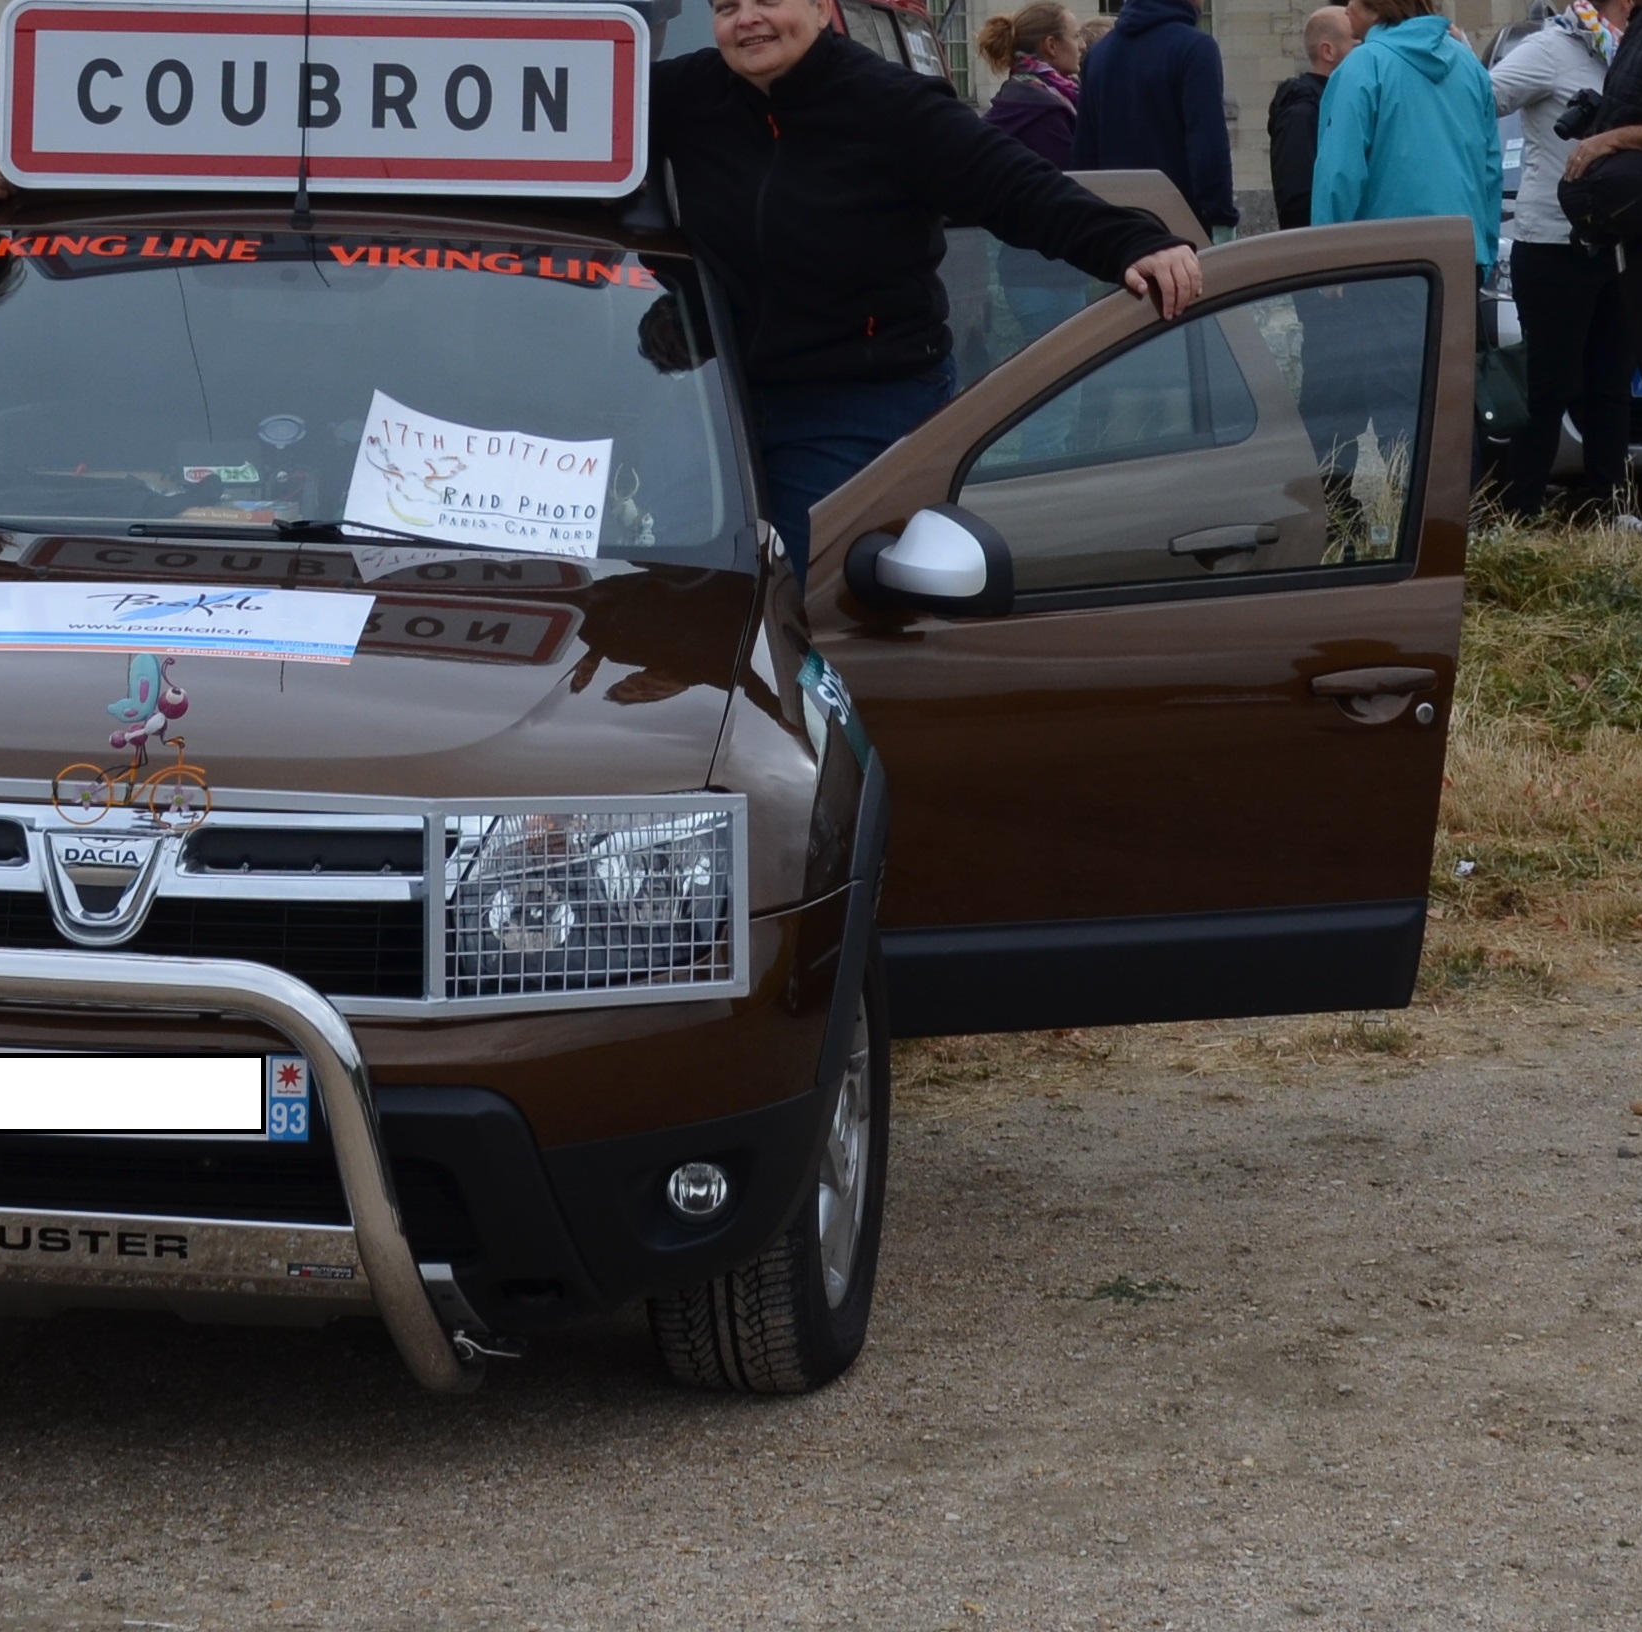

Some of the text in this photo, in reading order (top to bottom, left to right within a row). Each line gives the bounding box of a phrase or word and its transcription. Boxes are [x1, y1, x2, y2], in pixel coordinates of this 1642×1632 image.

[76, 58, 569, 133] COUBRON
[139, 235, 261, 262] LINE
[328, 244, 658, 291] VIKING LINE
[382, 419, 598, 476] 17TH EDITION
[443, 486, 597, 520] RAID PHOTO
[68, 623, 253, 636] www.parakalo.fr
[64, 848, 139, 864] DACIA
[270, 1101, 307, 1135] 93
